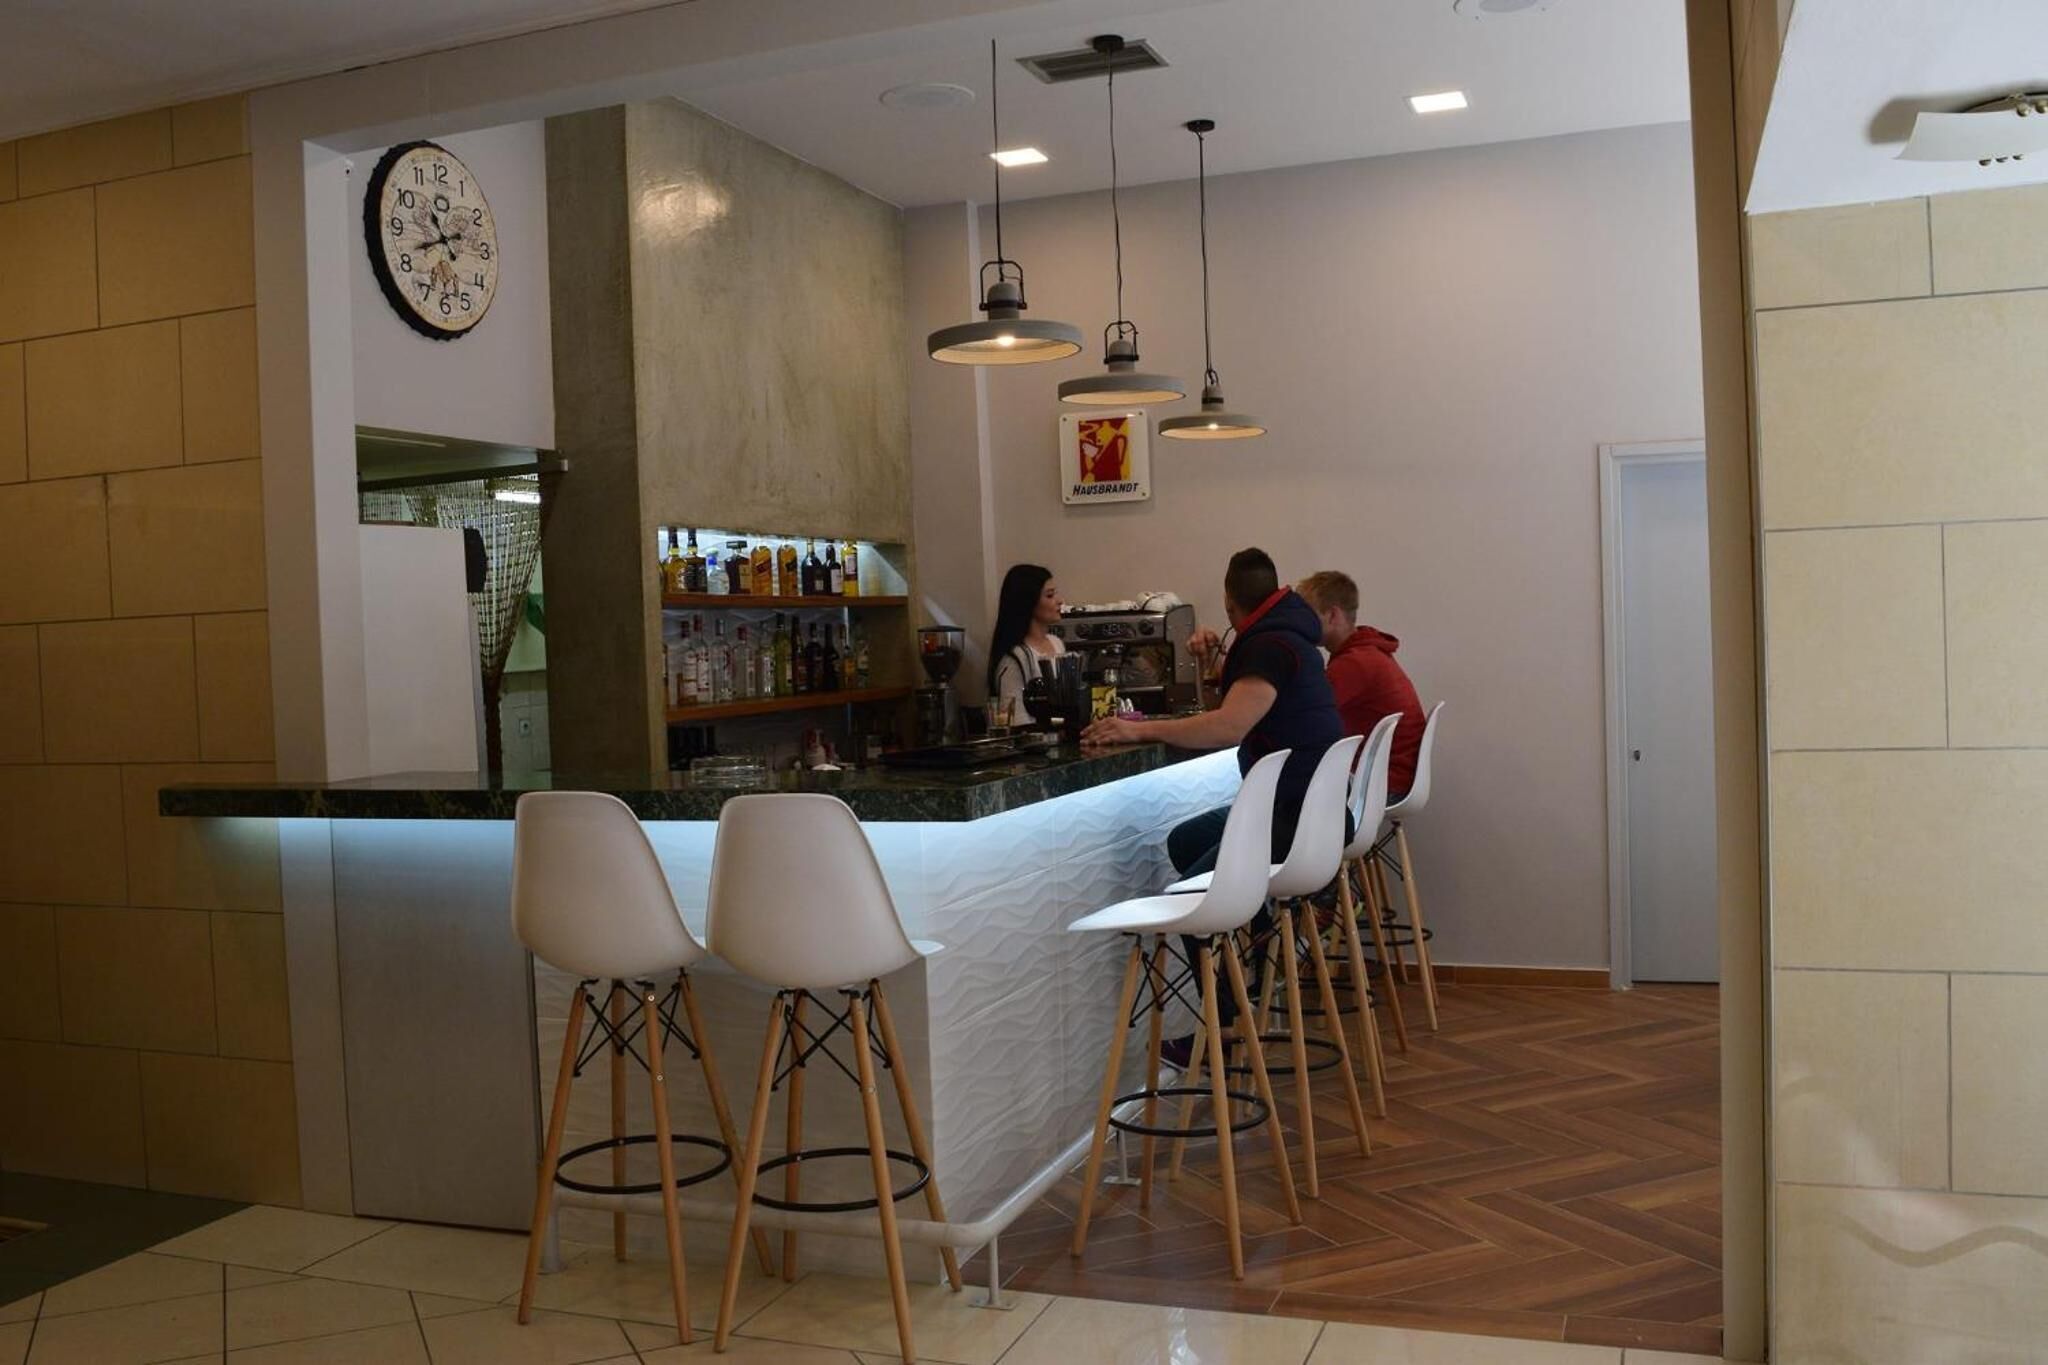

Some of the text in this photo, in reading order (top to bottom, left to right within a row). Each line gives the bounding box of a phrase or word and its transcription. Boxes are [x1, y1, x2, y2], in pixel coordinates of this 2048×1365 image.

[413, 166, 424, 186] 11
[433, 163, 449, 185] 12
[459, 180, 465, 197] 1
[397, 188, 415, 209] 10
[391, 217, 404, 236] 9
[472, 208, 483, 227] 2
[479, 242, 490, 261] 3
[400, 253, 412, 273] 8
[474, 273, 485, 291] 4
[418, 283, 432, 301] 7
[460, 292, 471, 311] 5
[439, 296, 452, 315] 6
[1072, 483, 1138, 495] HAUSBRANDT
